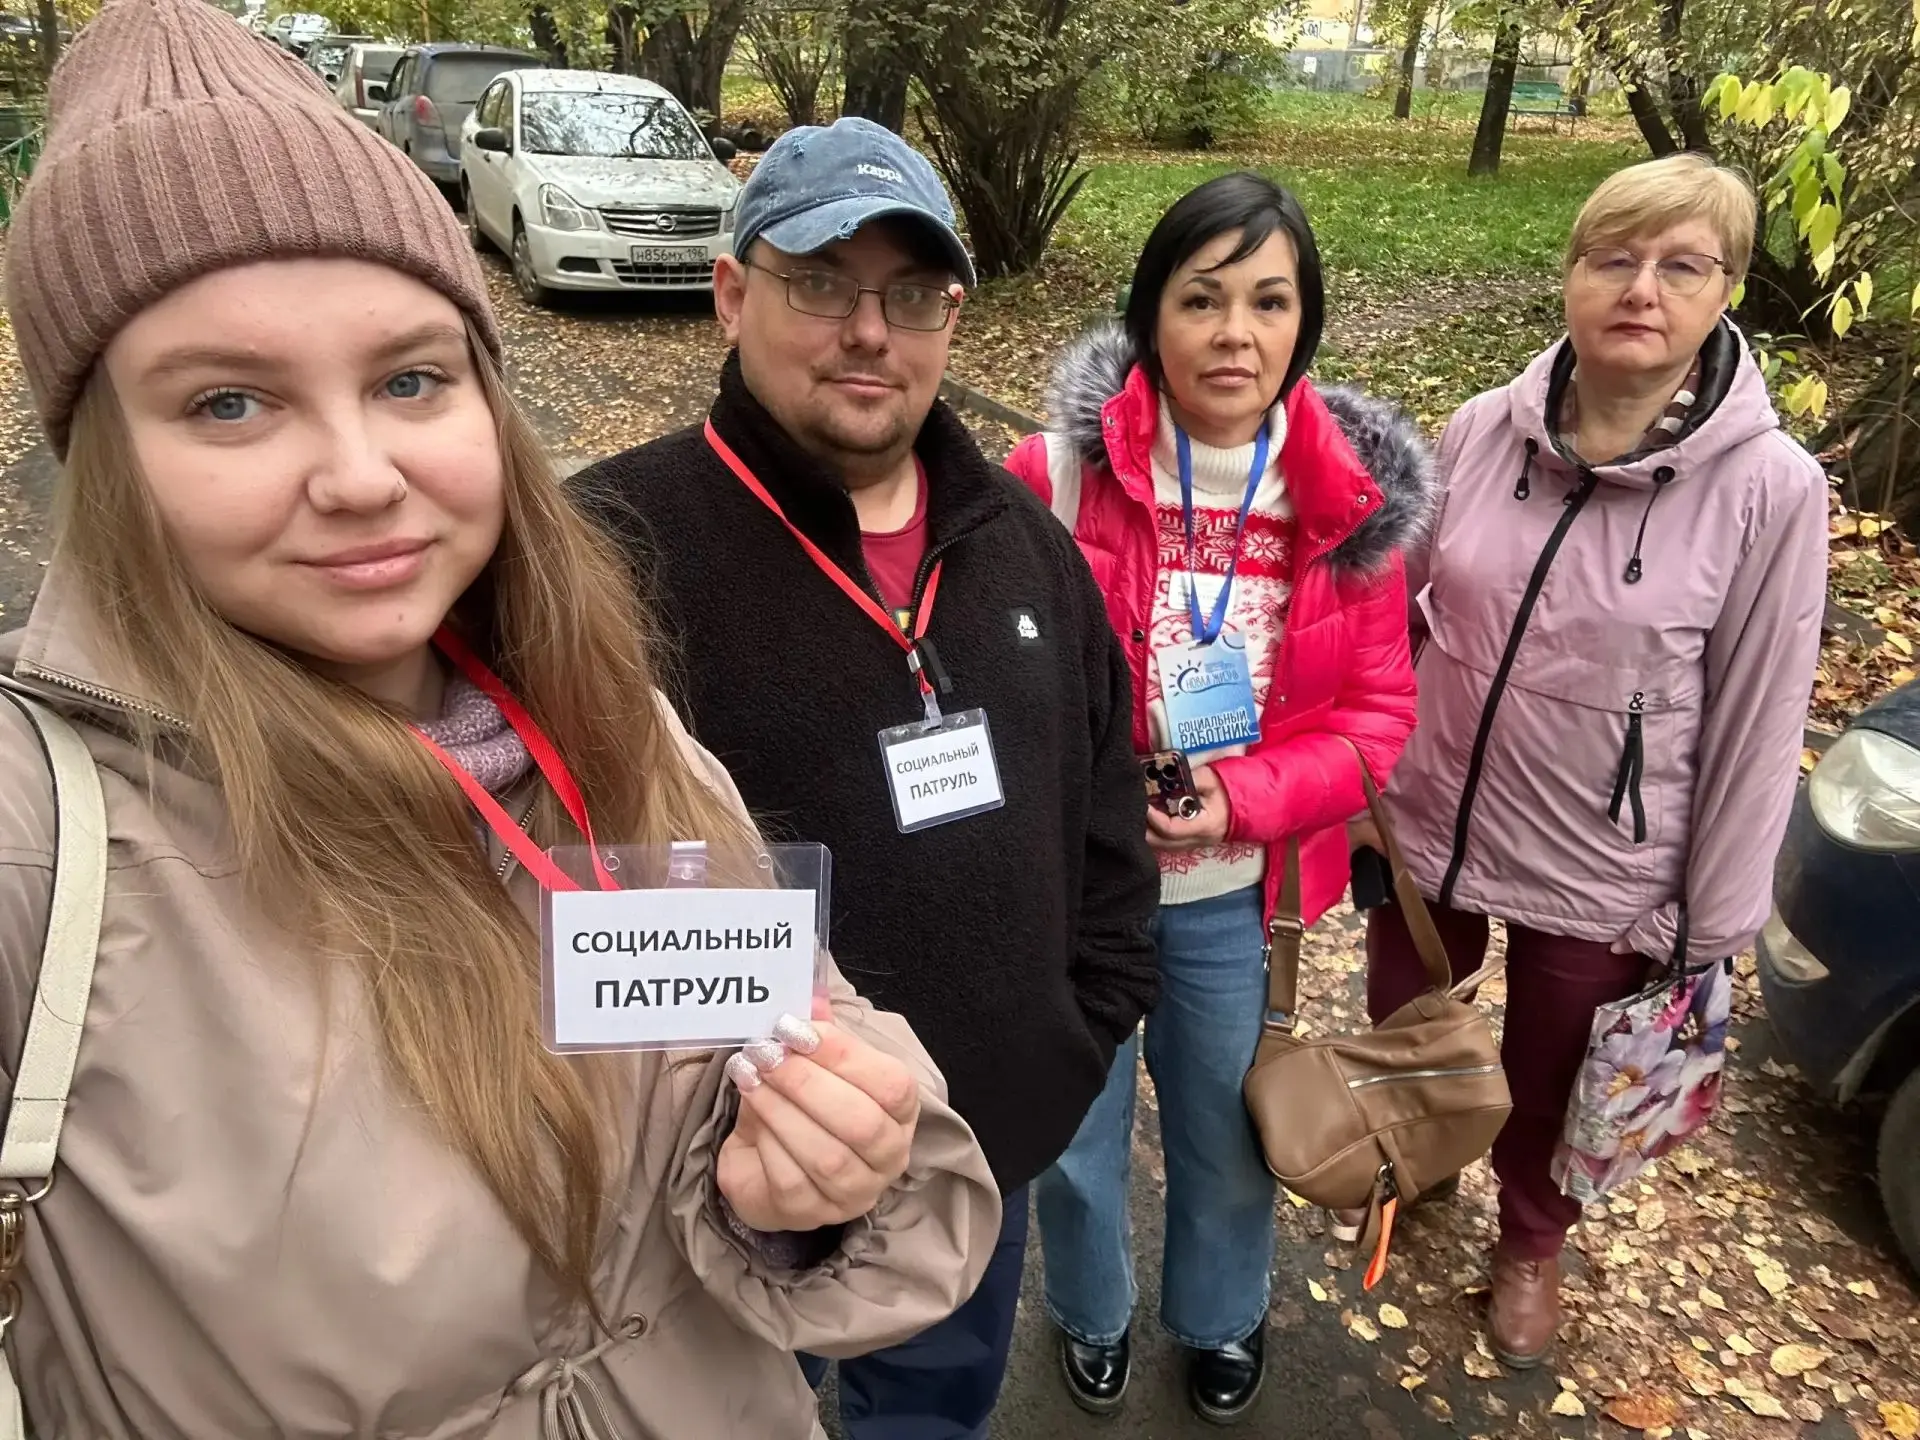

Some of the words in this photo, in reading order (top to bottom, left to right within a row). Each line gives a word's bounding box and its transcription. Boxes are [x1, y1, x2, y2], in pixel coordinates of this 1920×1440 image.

[857, 164, 903, 183] Kappa
[1178, 708, 1247, 734] СОЦИАЛЬНЫЙ
[1180, 720, 1250, 750] РАБОТНИК
[896, 741, 980, 774] СОЦИАЛЬНЫЙ
[909, 771, 978, 800] ПАТРУЛЬ
[572, 922, 792, 957] СОЦИАЛЬНЫЙ
[595, 976, 770, 1009] ПАТРУЛЬ
